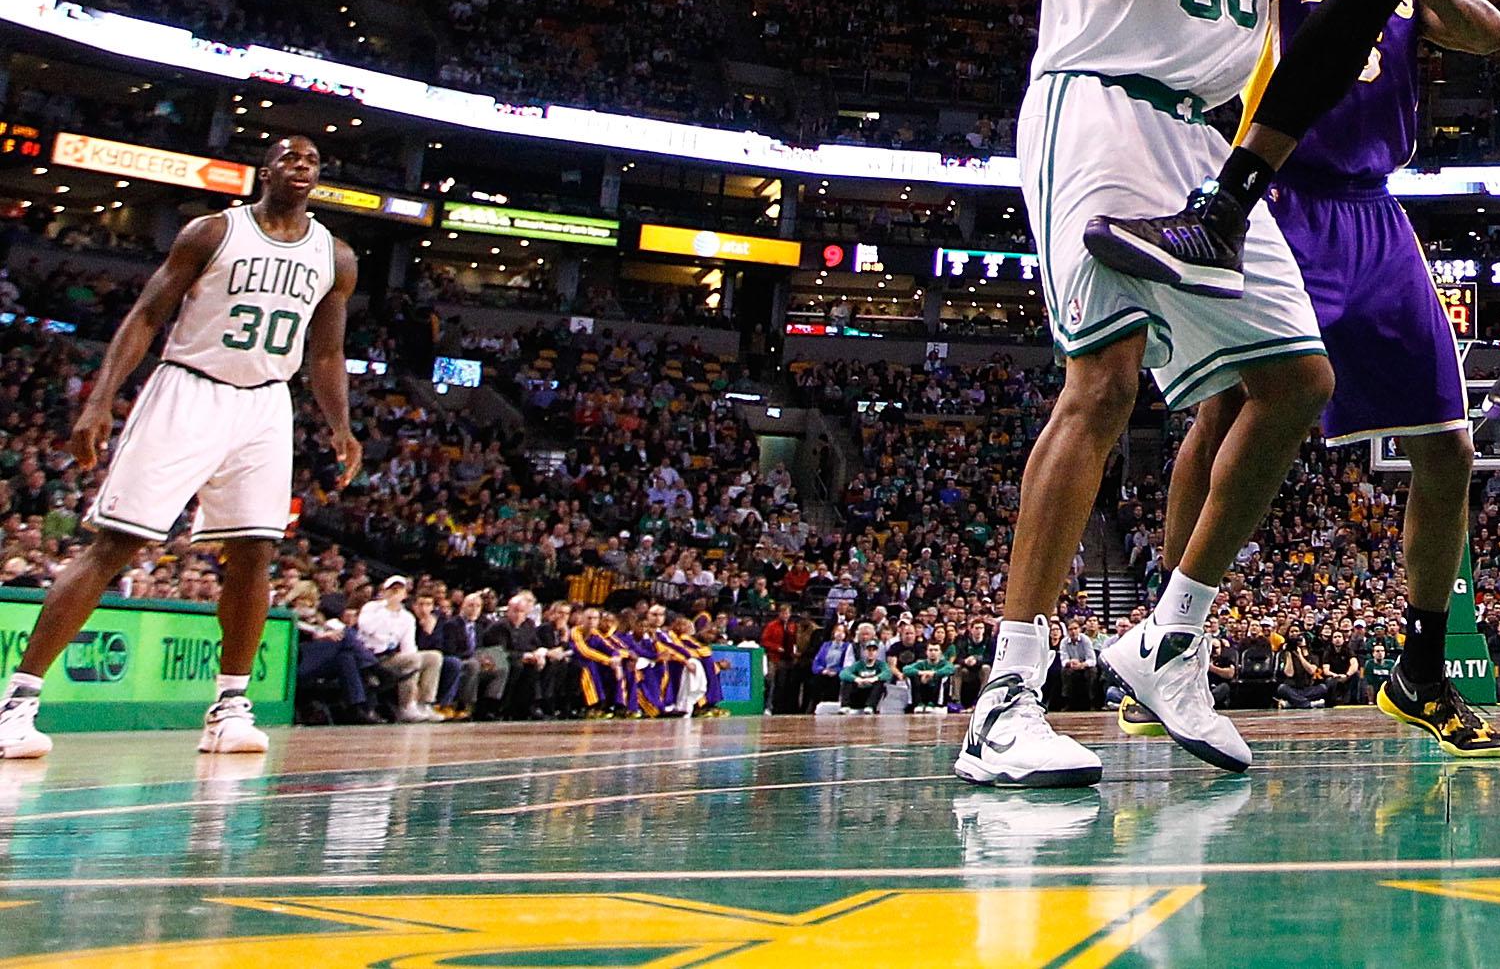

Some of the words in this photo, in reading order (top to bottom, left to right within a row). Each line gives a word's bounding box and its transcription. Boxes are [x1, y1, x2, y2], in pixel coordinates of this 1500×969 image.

[91, 145, 188, 178] KYOCERA
[823, 245, 843, 267] 9
[227, 257, 319, 305] CELTICS
[222, 304, 301, 355] 30
[162, 636, 268, 681] THURSS
[1445, 660, 1464, 678] BA
[1465, 659, 1488, 678] TV
